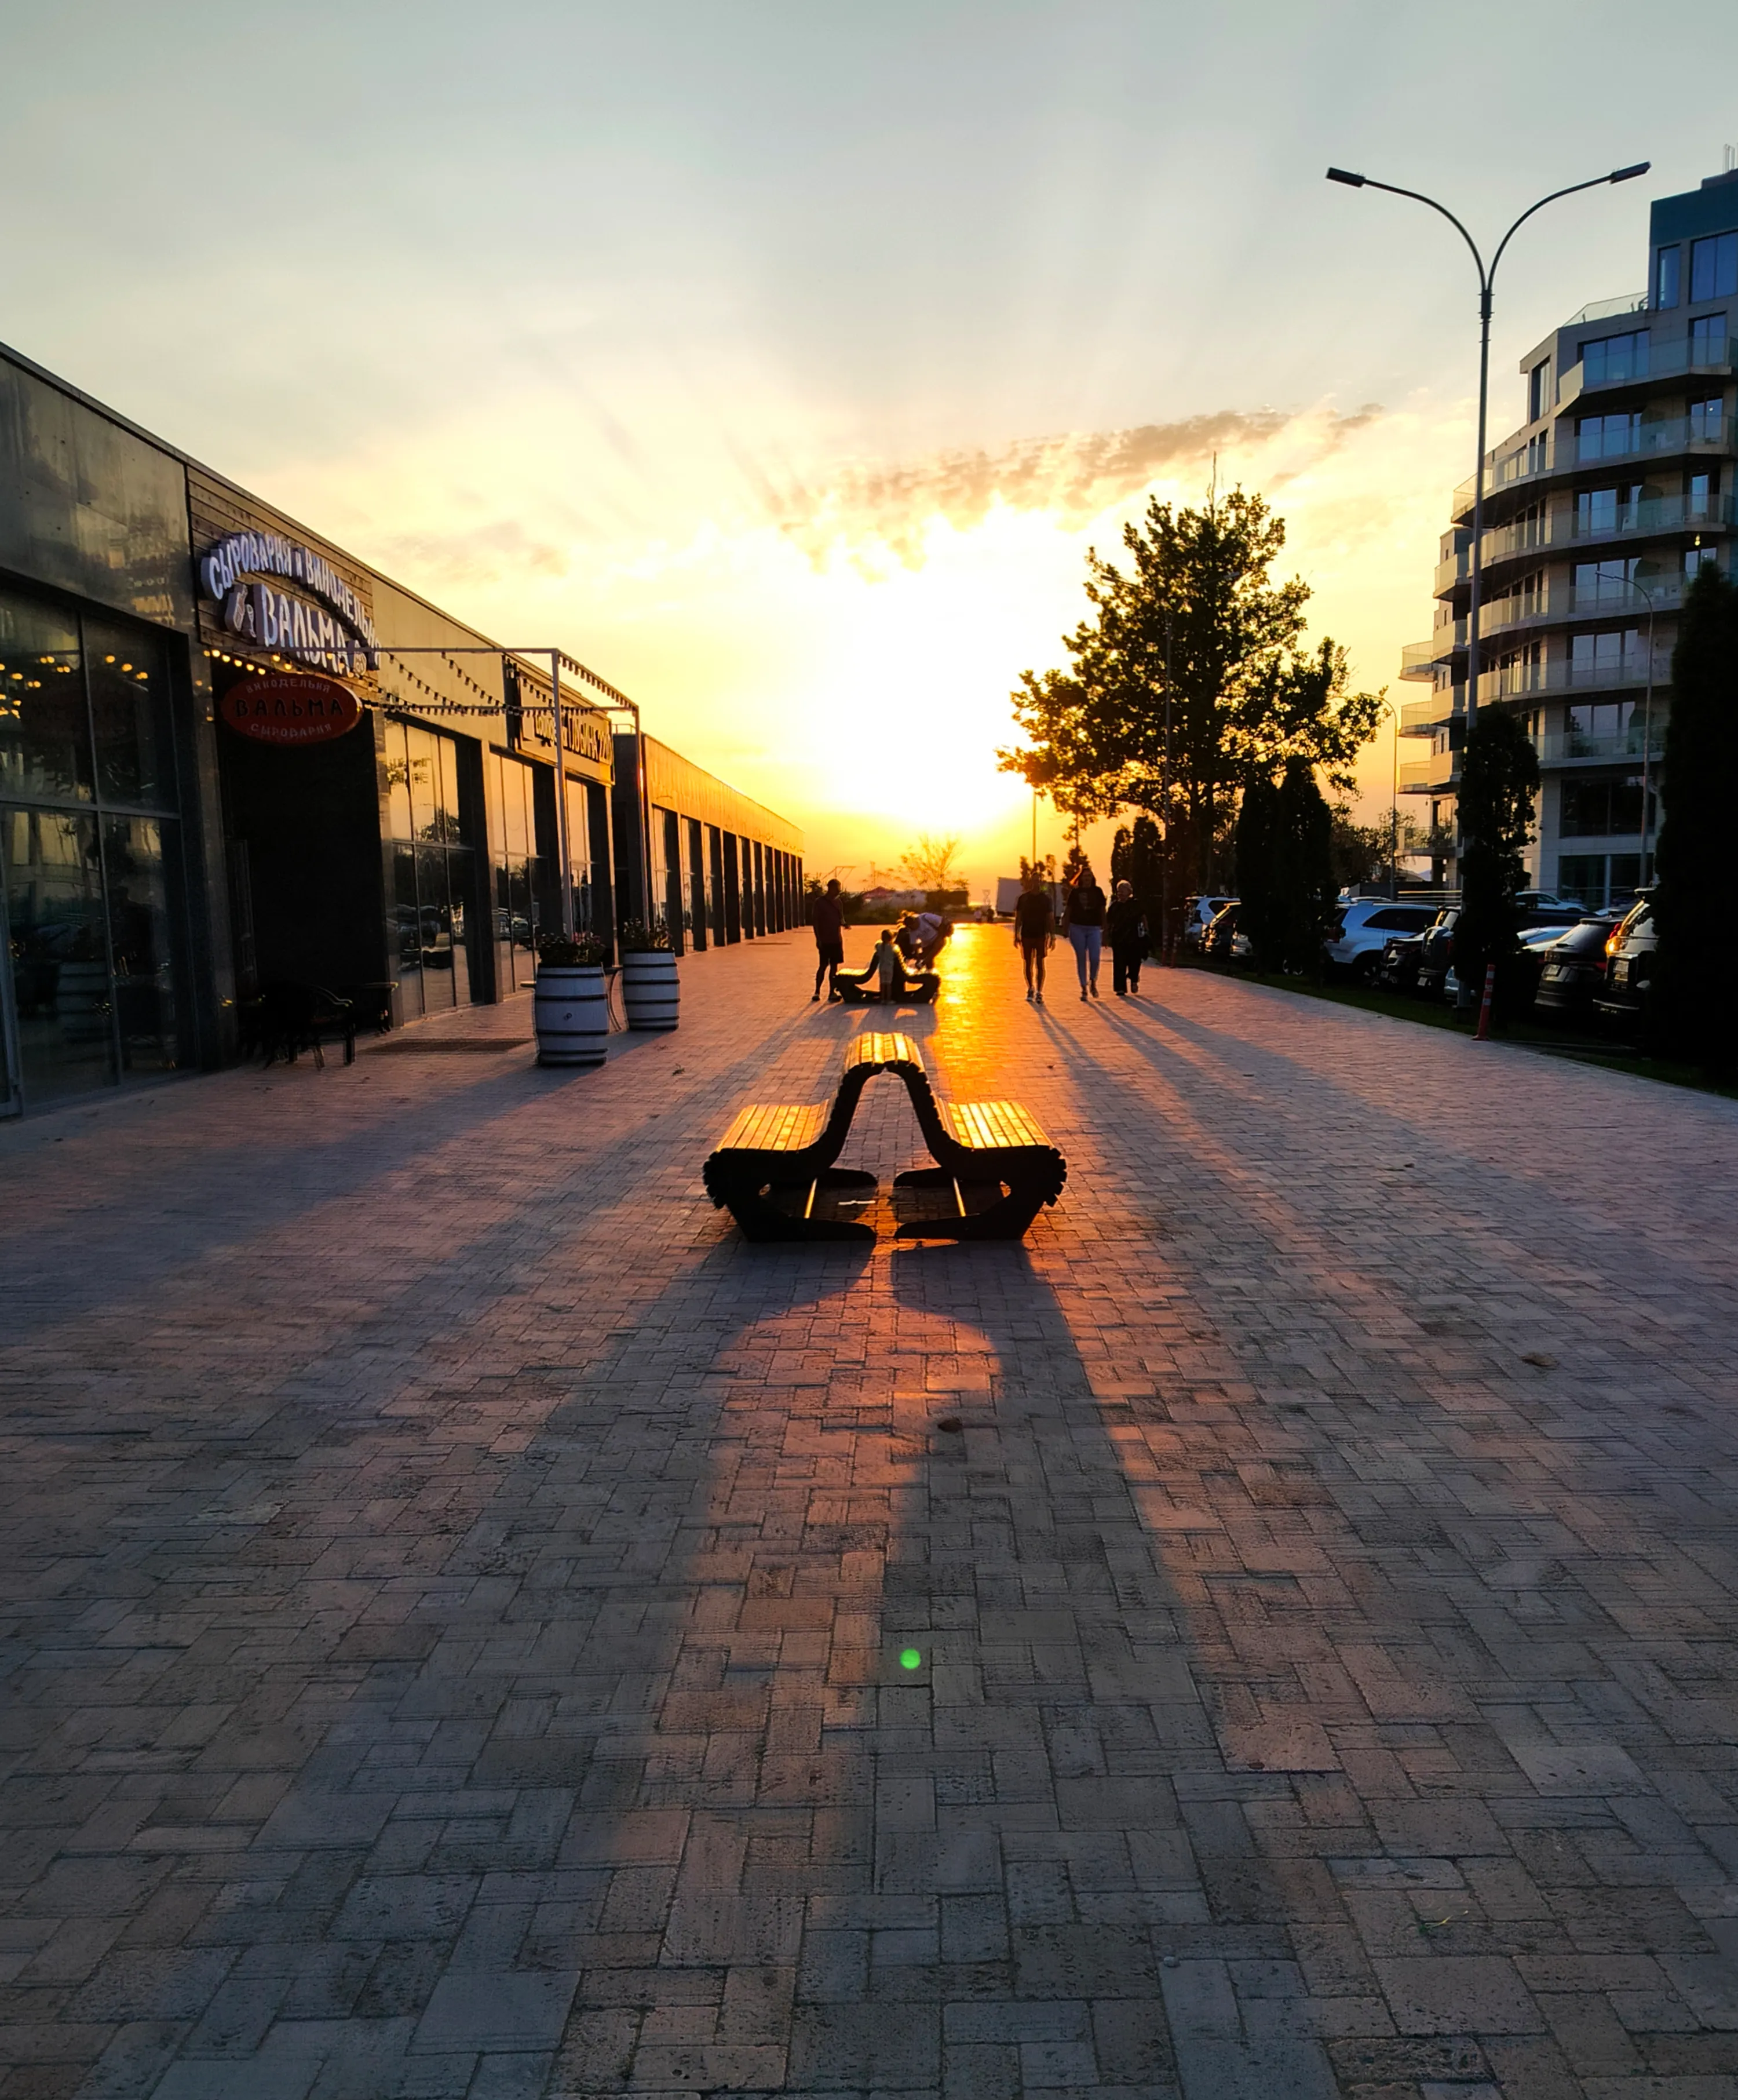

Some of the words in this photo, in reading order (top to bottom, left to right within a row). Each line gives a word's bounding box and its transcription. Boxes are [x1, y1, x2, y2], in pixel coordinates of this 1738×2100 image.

[208, 533, 292, 600] СЫРОВАРНЯ
[304, 547, 381, 668] ВИНОДЕЛЬНЯ
[261, 584, 350, 677] ВАЛЬМА
[236, 697, 343, 718] ВАЛЬМА
[250, 723, 332, 738] СЫРОВАРНЯ
